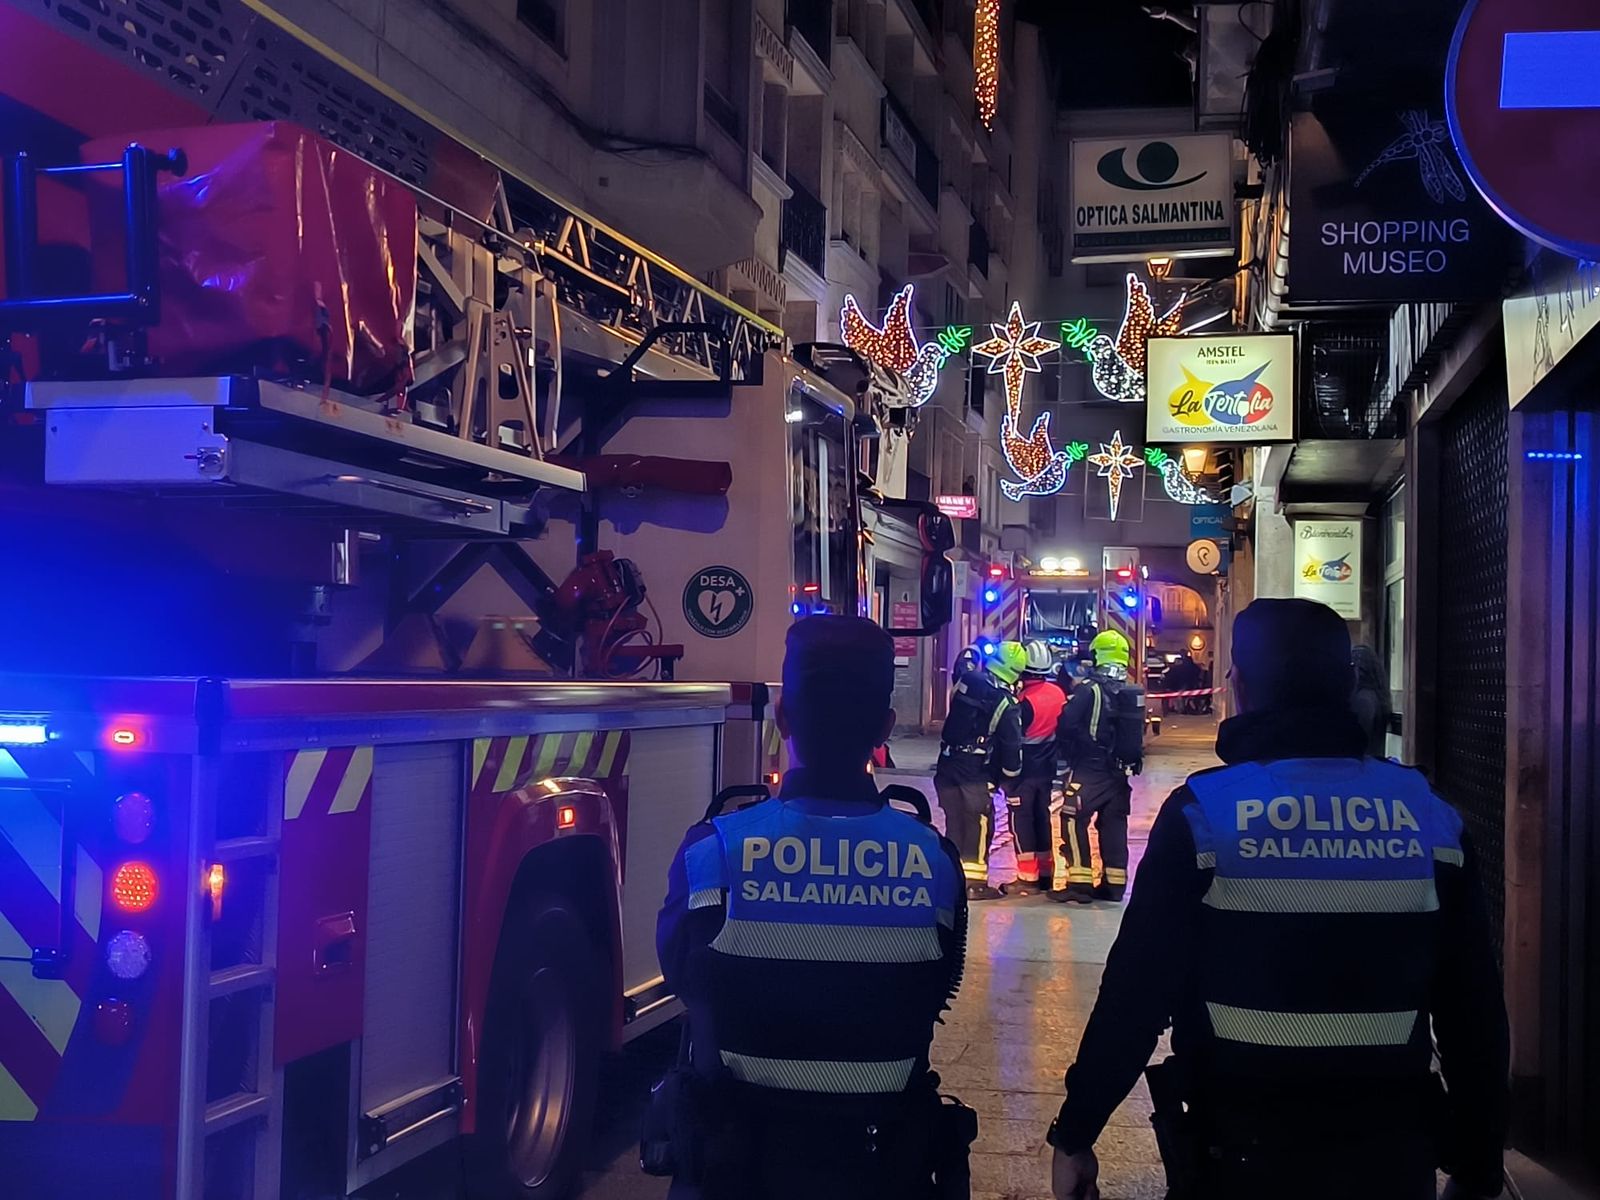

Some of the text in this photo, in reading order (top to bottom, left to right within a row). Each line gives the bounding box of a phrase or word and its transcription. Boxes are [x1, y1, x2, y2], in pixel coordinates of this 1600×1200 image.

[1076, 200, 1224, 227] OPTICA SALMANTINA
[1320, 218, 1470, 246] SHOPPING
[1343, 249, 1447, 275] MUSEO
[1197, 345, 1246, 359] AMSTEL
[1169, 389, 1203, 417] La
[1162, 423, 1278, 435] GASTRONOMÍA VENEZOLANA
[700, 575, 736, 587] DESA
[1236, 795, 1420, 832] POLICIA
[742, 836, 933, 880] POLICIA
[1239, 837, 1425, 859] SALAMANCA
[742, 879, 933, 908] SALAMANCA
